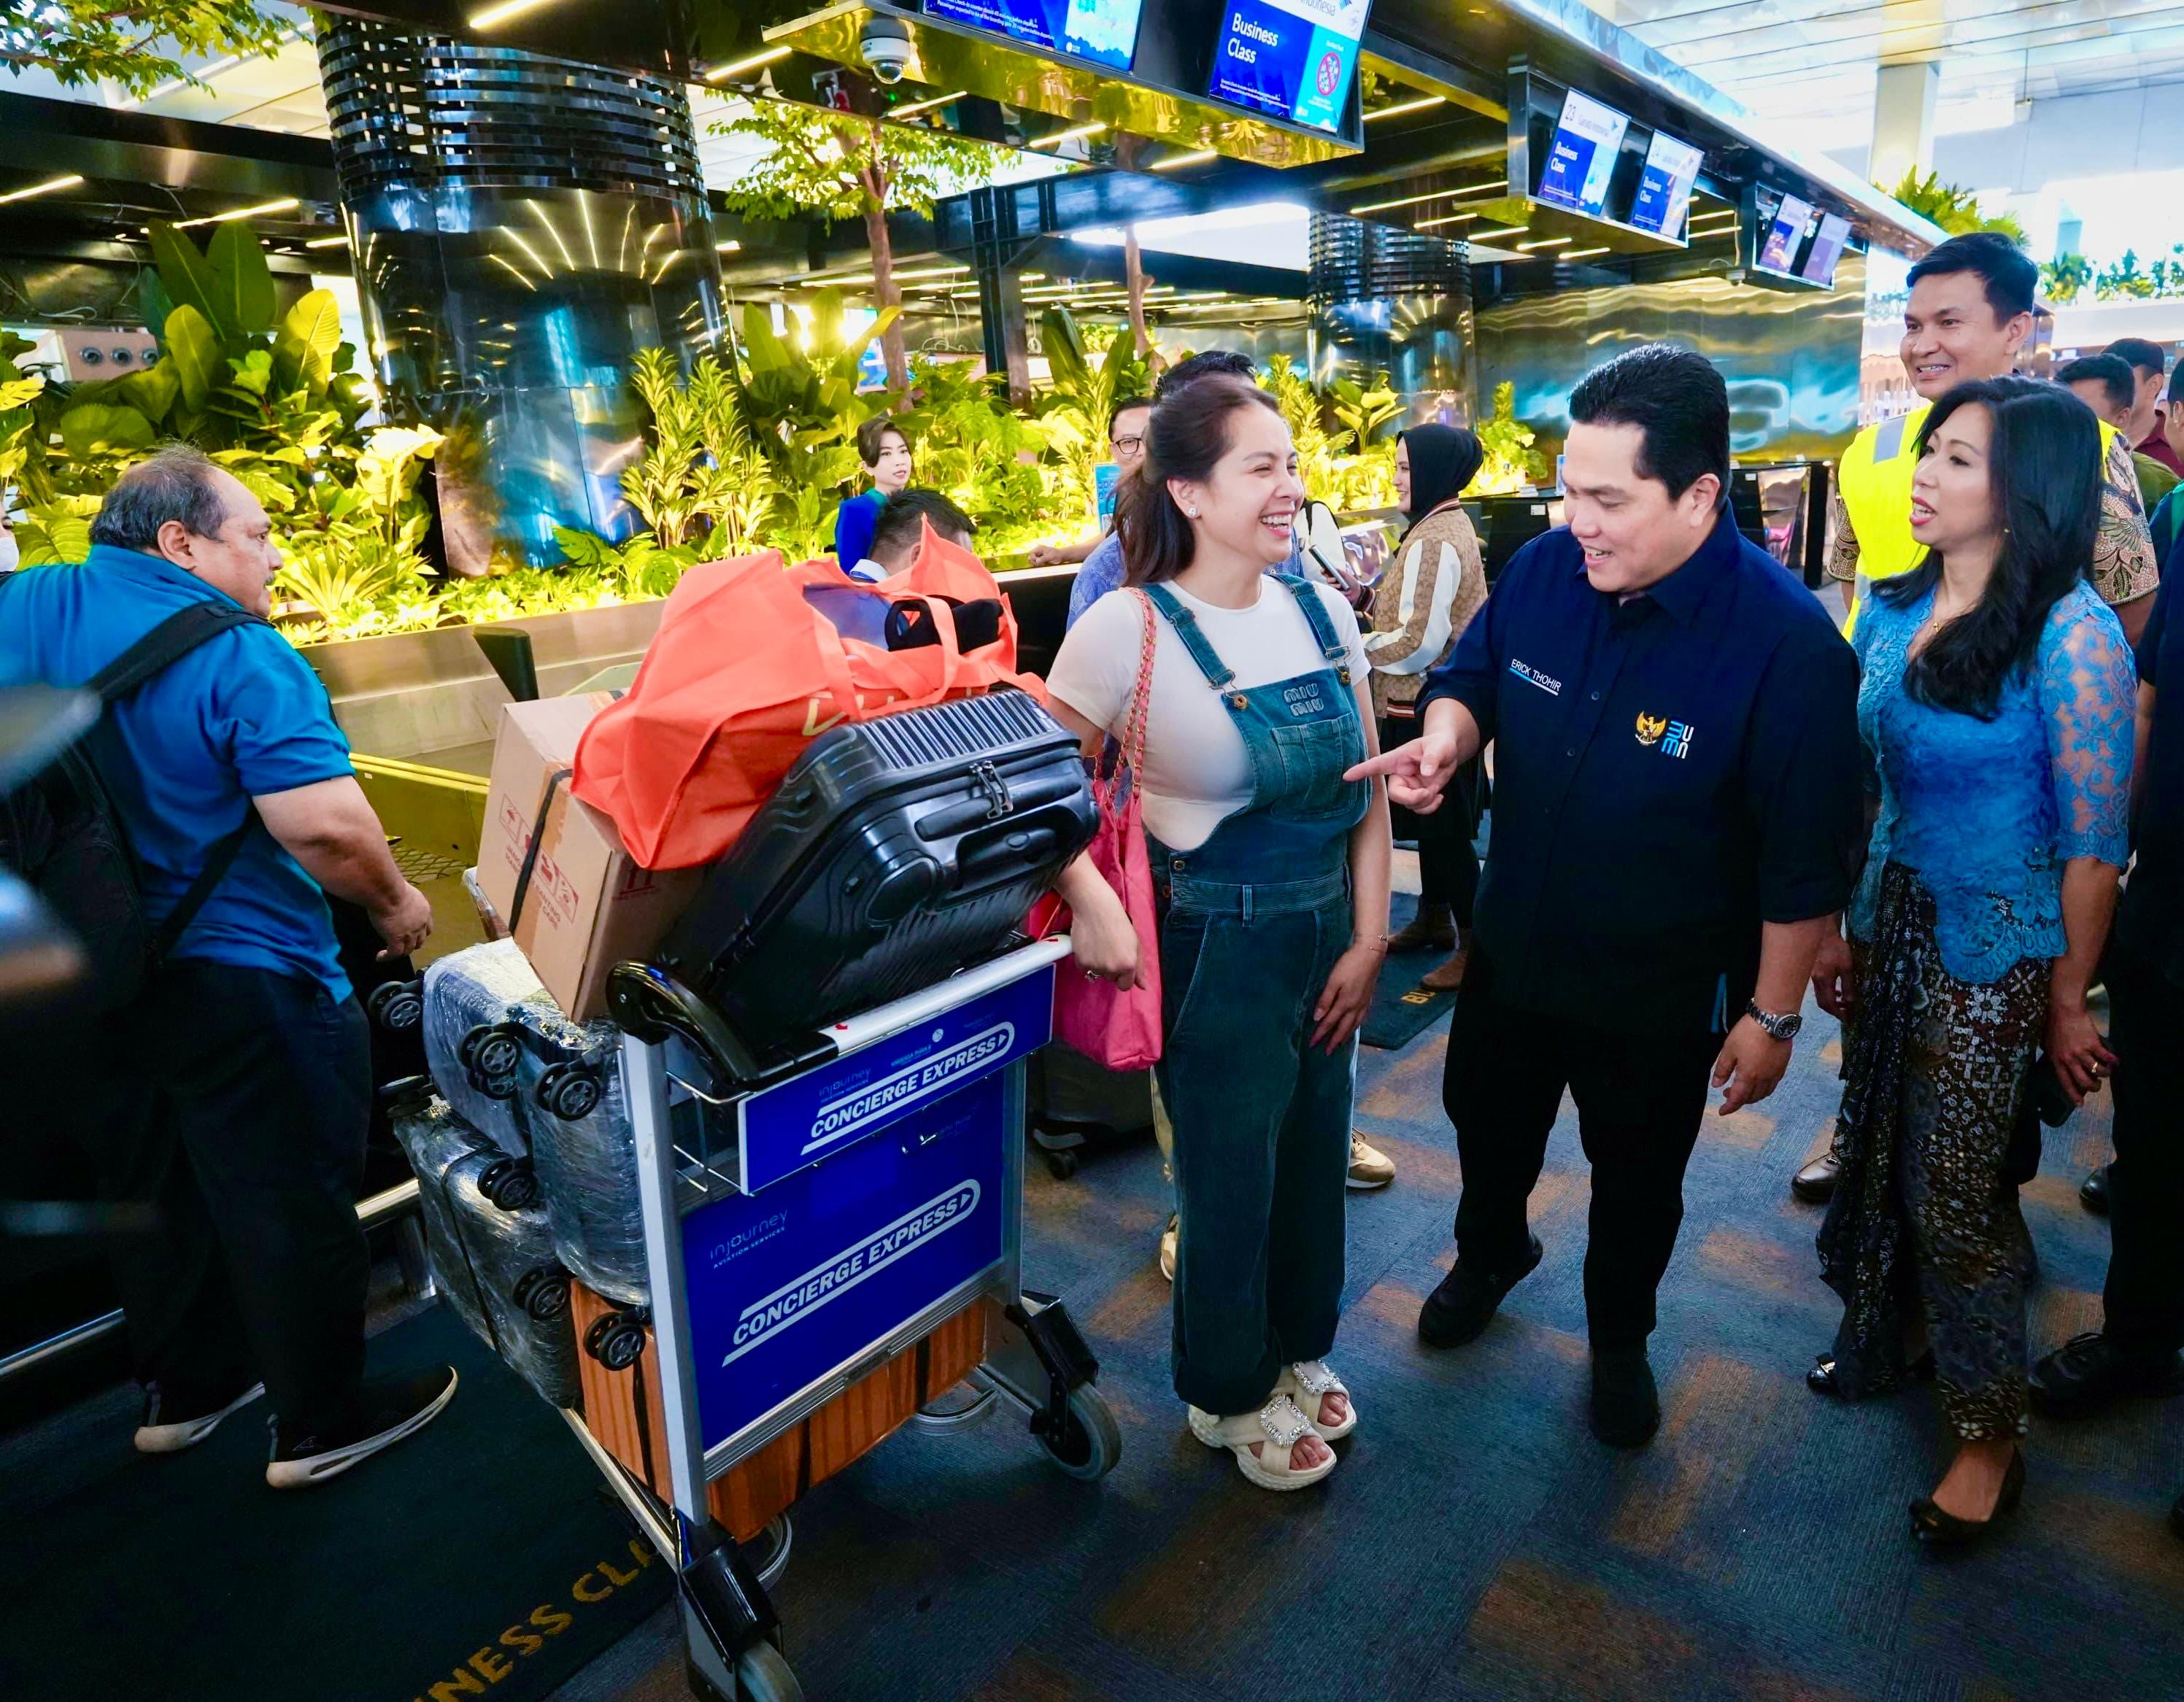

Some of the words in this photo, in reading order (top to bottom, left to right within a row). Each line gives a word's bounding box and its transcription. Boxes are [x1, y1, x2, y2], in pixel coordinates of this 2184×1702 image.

[1232, 12, 1278, 47] Business
[1227, 38, 1257, 63] Class
[1564, 104, 1576, 121] 23
[1551, 157, 1566, 174] Class
[1554, 141, 1578, 161] Business
[1510, 659, 1532, 676] ERICK
[1532, 669, 1562, 692] THOHIR
[811, 1074, 919, 1138] CONCIERGE
[922, 1037, 996, 1086] EXPRESS
[819, 1068, 871, 1097] injourney
[710, 1210, 787, 1260] injourney
[714, 1247, 749, 1269] AVIATION
[751, 1226, 785, 1248] SERVICES
[733, 1253, 864, 1345] CONCIERGE
[868, 1198, 958, 1265] EXPRESS
[414, 1604, 573, 1702] NESS
